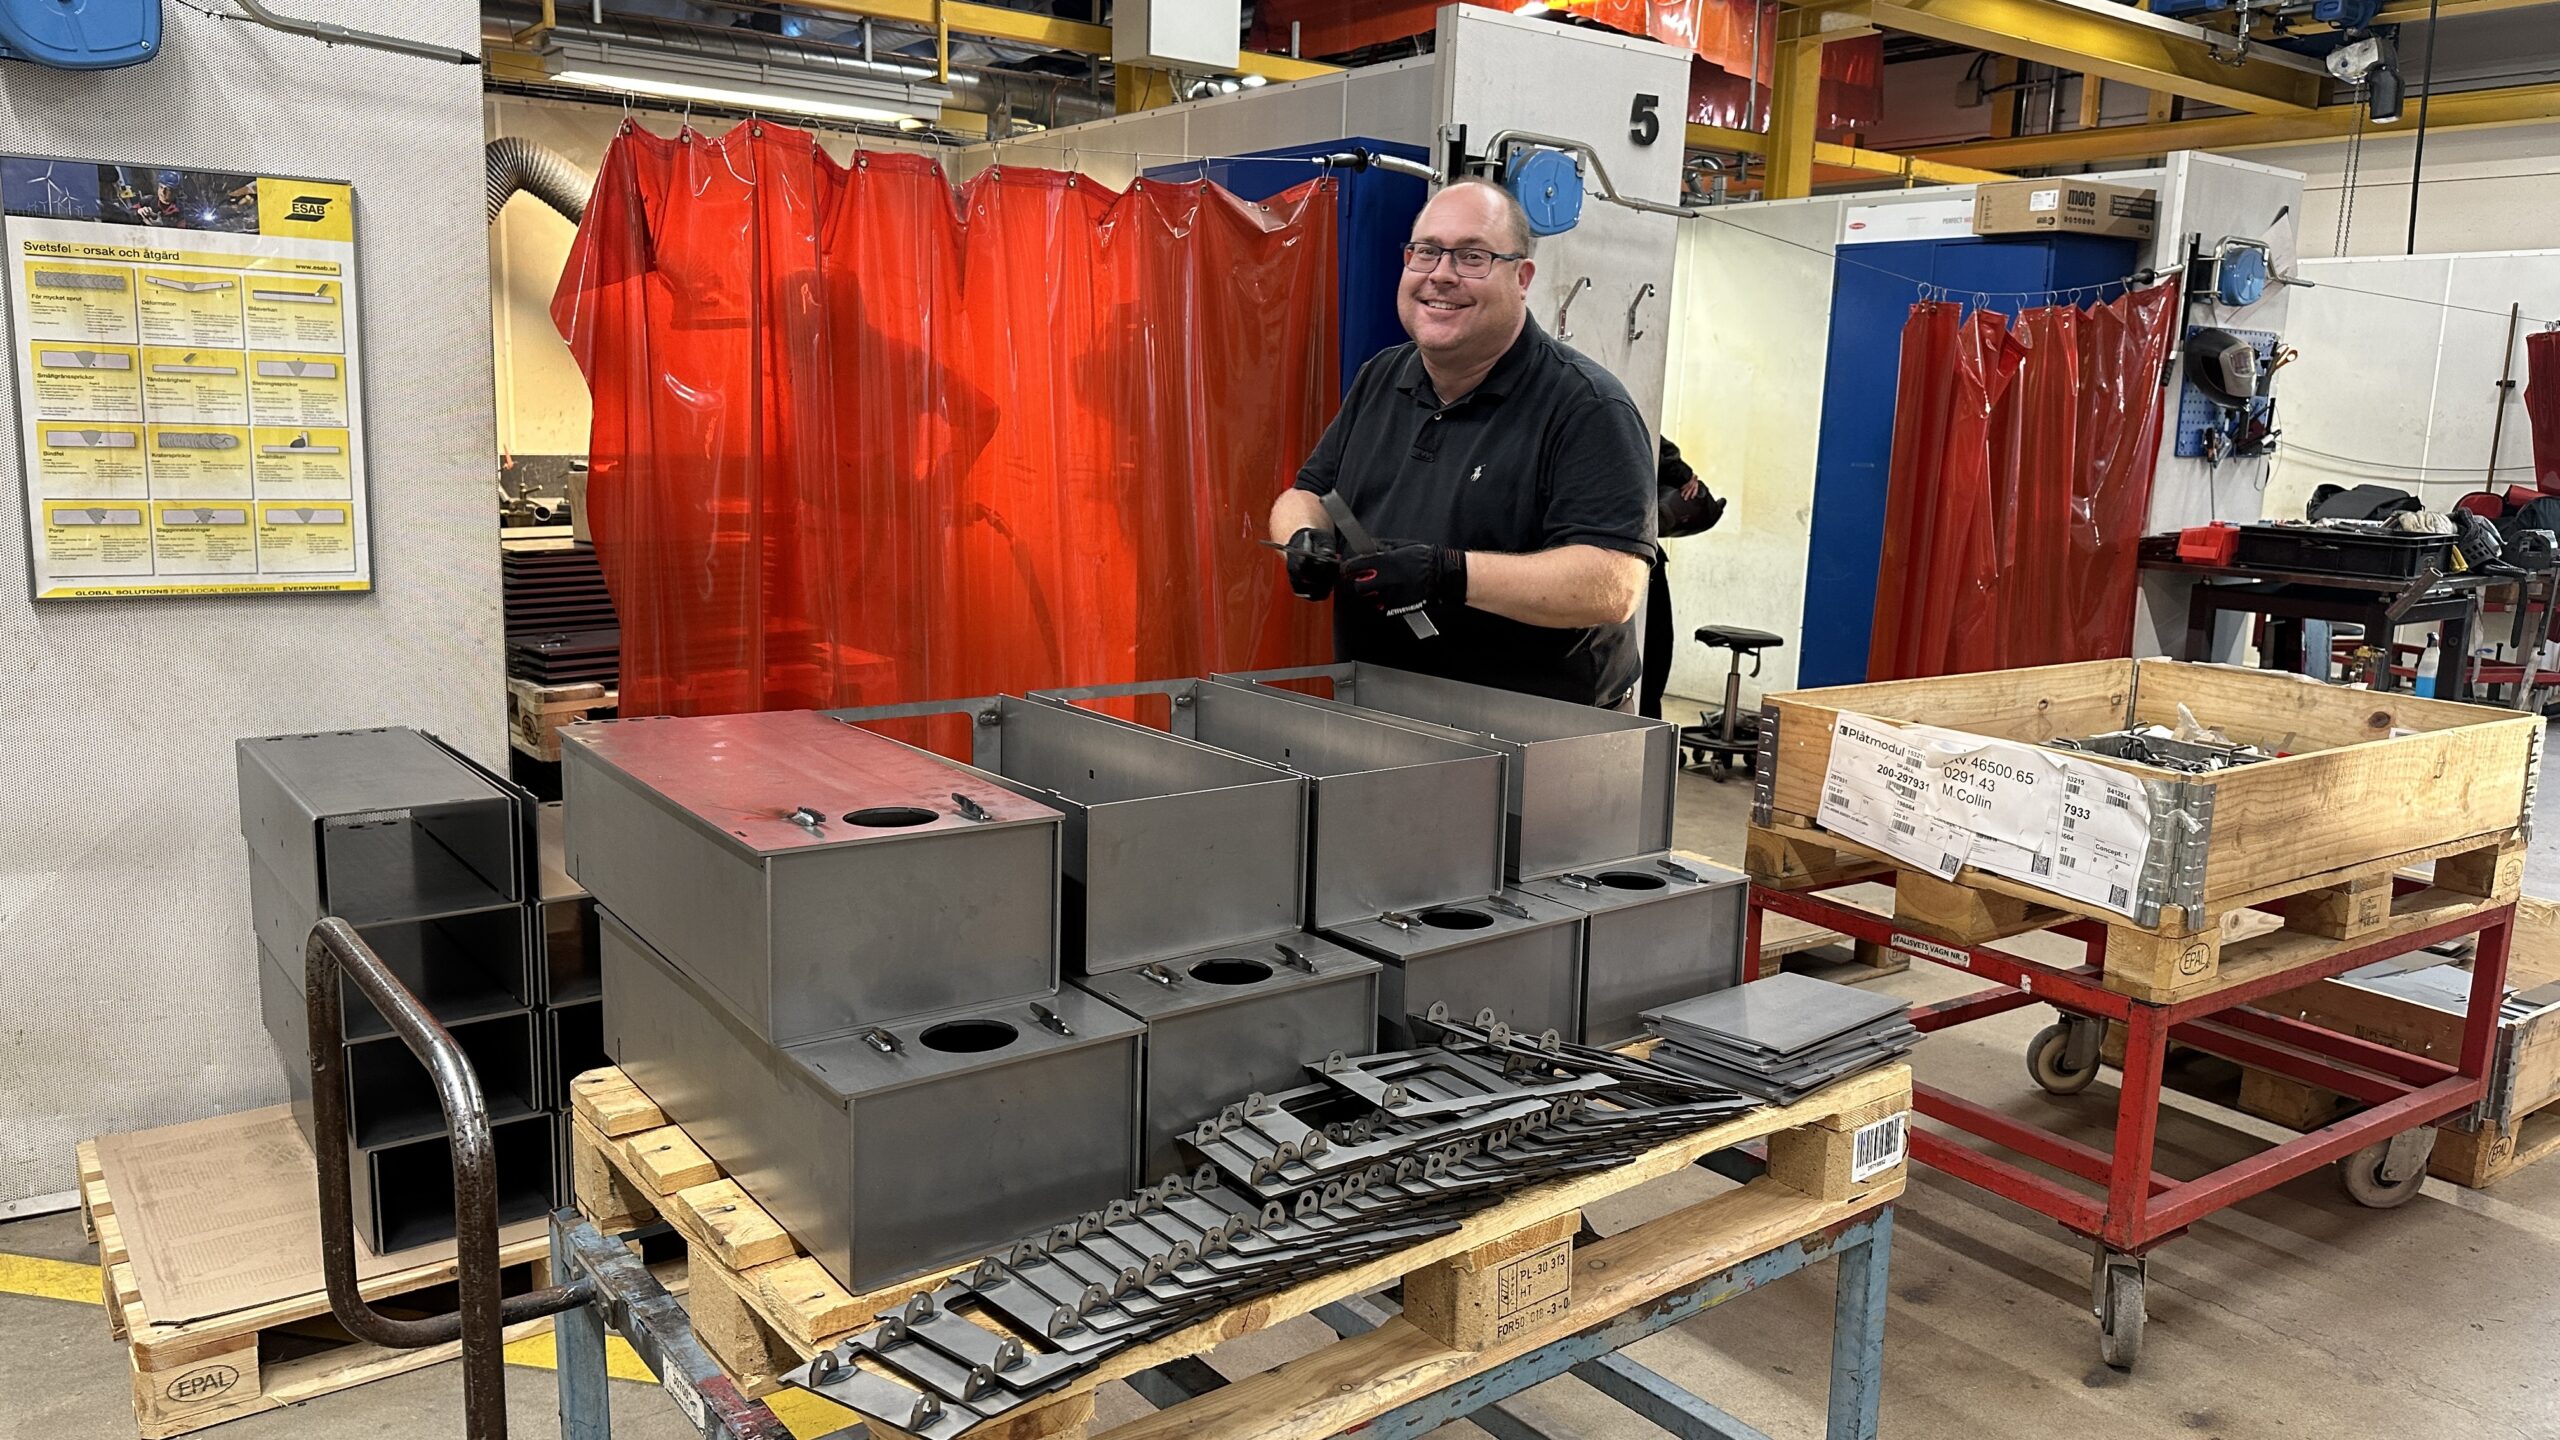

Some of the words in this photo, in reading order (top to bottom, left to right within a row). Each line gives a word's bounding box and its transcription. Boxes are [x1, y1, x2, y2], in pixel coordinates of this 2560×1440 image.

[1631, 93, 1659, 146] 5
[292, 203, 325, 215] ESAB
[2068, 190, 2095, 207] more
[23, 241, 71, 254] Svetsfel
[83, 246, 115, 257] orsak
[119, 248, 140, 258] och
[143, 249, 180, 261] åtgärd
[295, 263, 337, 272] www.esab.se
[1848, 727, 1905, 757] Plåtmodul
[1877, 764, 1930, 793] 200-297931
[1944, 767, 1996, 792] 0291.43
[1942, 783, 1992, 810] M.Collin
[2064, 803, 2091, 820] 7933
[2183, 948, 2206, 970] EPAL
[1551, 1254, 1565, 1270] 313
[1520, 1284, 1533, 1299] HT
[178, 1371, 231, 1399] EPAL
